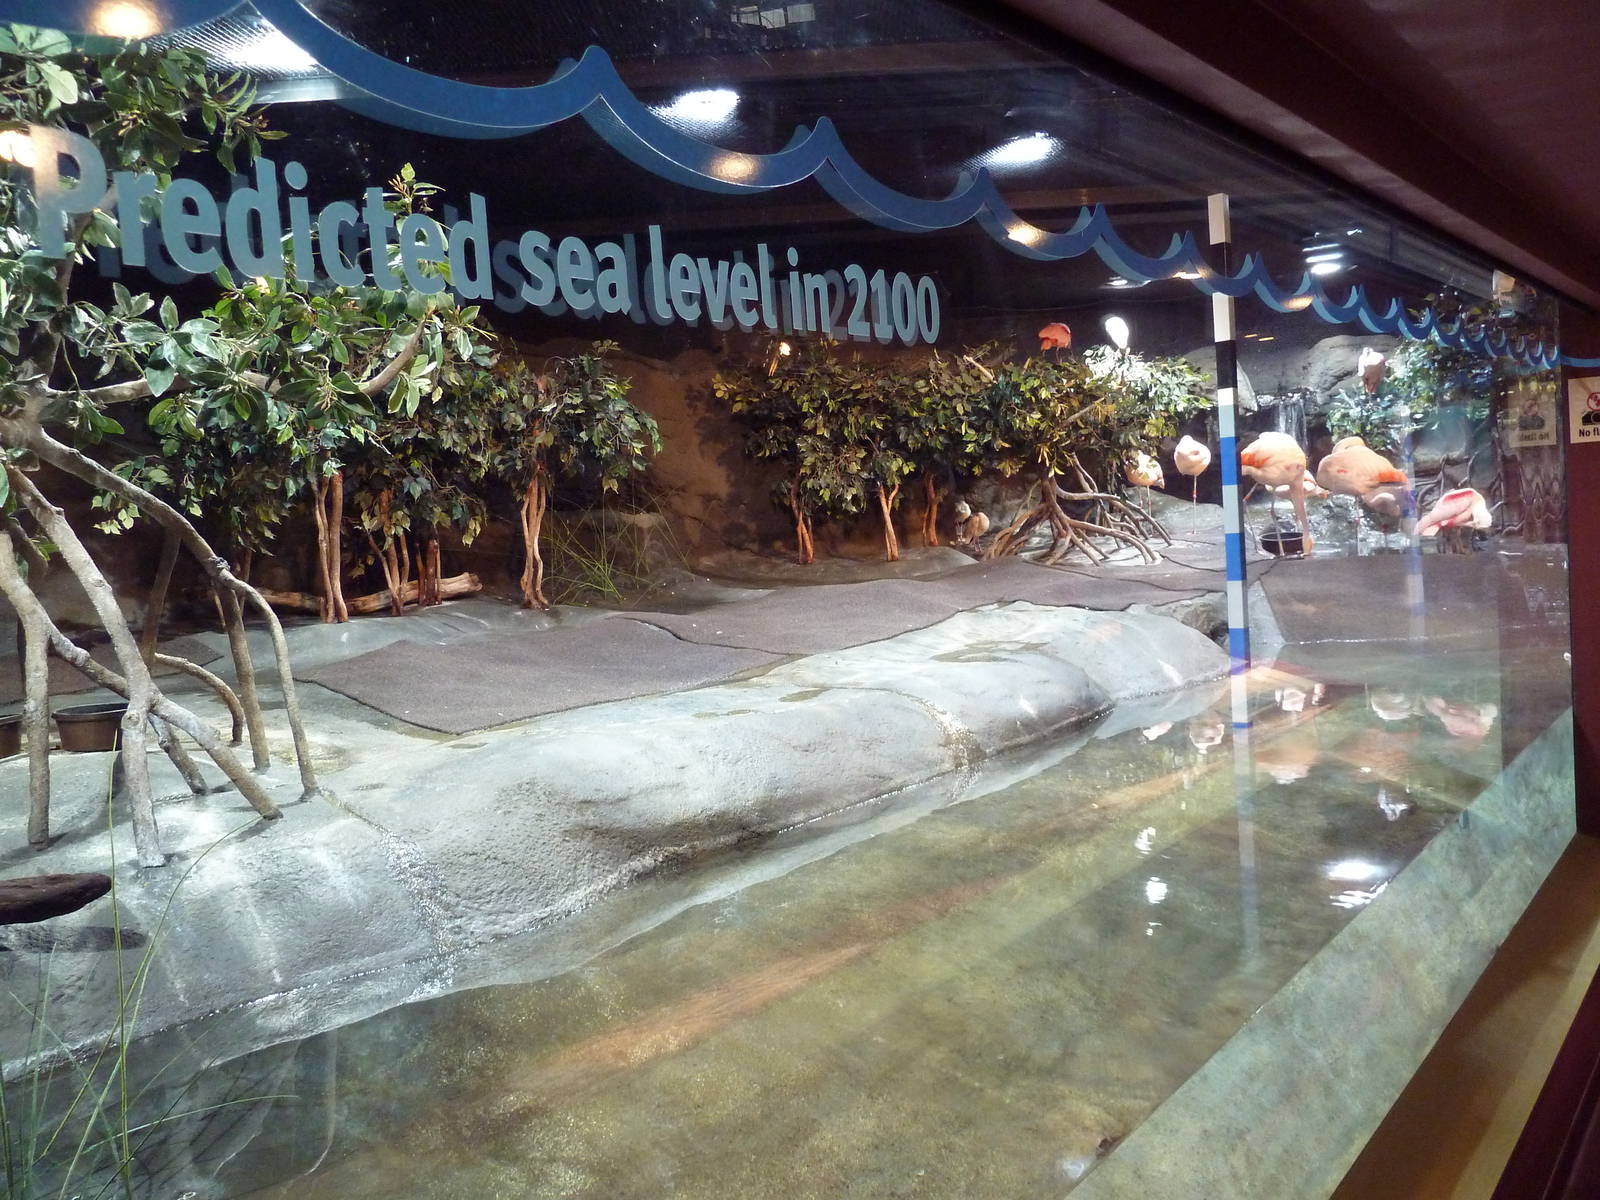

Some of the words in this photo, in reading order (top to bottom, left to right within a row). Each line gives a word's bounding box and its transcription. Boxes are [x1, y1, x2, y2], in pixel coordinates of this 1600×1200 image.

[32, 124, 494, 300] Predicted
[520, 230, 631, 315] sea
[649, 224, 777, 329] level
[787, 246, 831, 333] in
[843, 263, 941, 344] 2100
[1579, 428, 1591, 437] No
